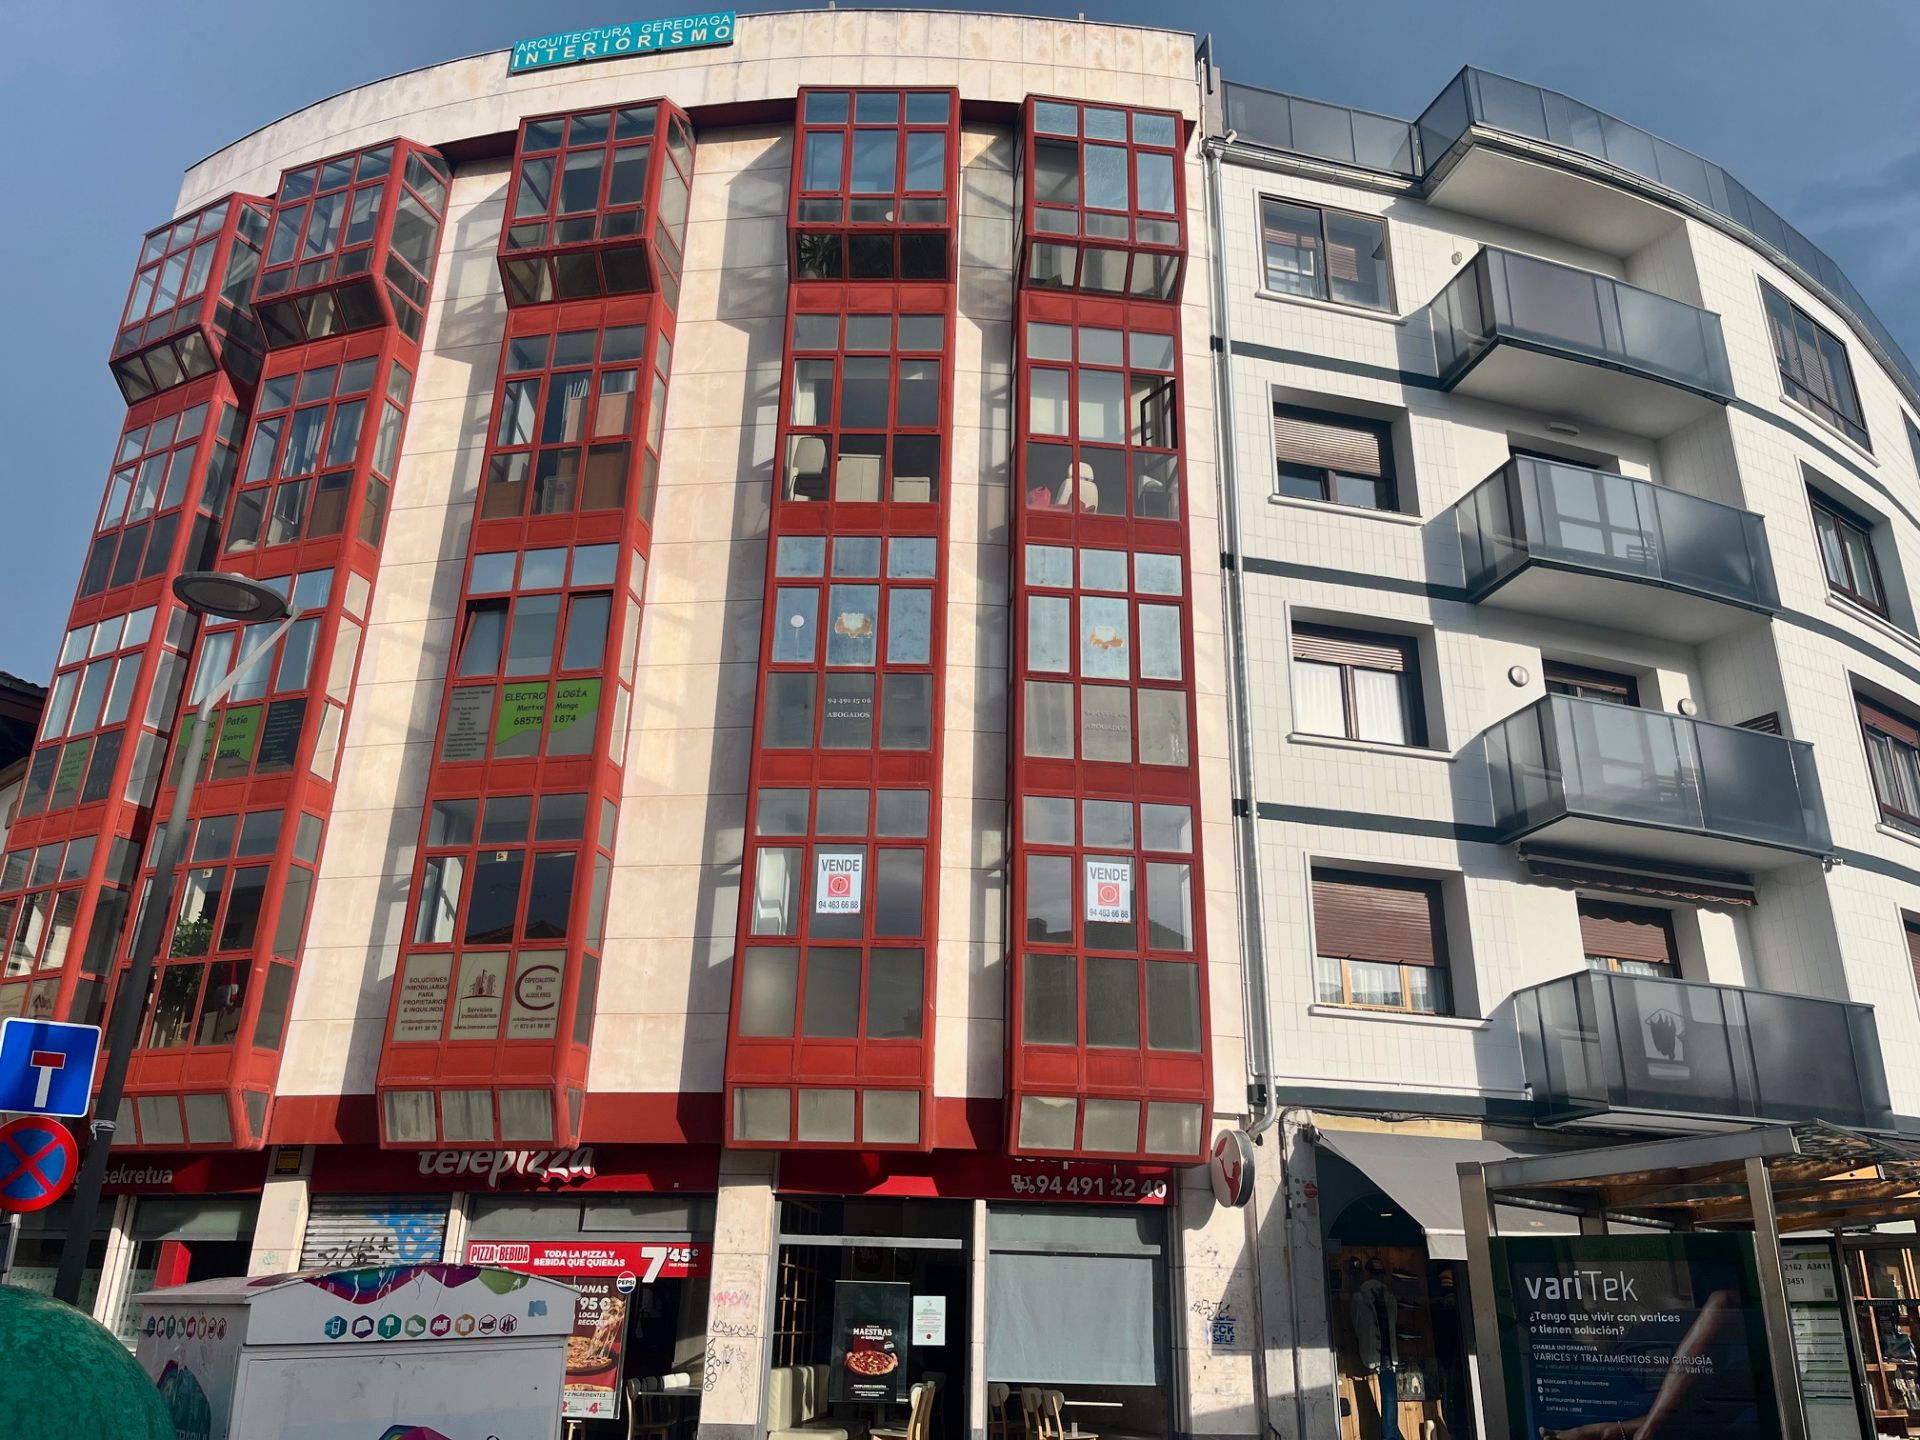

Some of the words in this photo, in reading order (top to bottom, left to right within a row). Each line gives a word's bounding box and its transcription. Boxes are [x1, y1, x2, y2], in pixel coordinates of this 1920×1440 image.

[517, 27, 631, 53] ARQUITECTURA
[641, 15, 731, 34] GEREDIAGA
[514, 26, 730, 67] INTERIORISMO
[505, 692, 546, 701] ELECTRO
[557, 687, 587, 698] LOGÍA
[821, 859, 860, 872] VENDE
[1090, 867, 1128, 881] VENDE
[818, 901, 827, 909] 94
[102, 1163, 173, 1184] sekretua
[418, 1147, 595, 1188] telepizza
[1036, 1175, 1063, 1194] 94
[1066, 1176, 1104, 1196] 491
[1110, 1178, 1136, 1197] 22
[1140, 1179, 1168, 1199] 40
[471, 1246, 495, 1261] PIZZA
[499, 1246, 529, 1261] BEBIDA
[544, 1250, 567, 1258] TODA
[569, 1250, 580, 1258] LA
[581, 1250, 606, 1258] PIZZA
[607, 1250, 616, 1258] Y
[533, 1258, 563, 1267] BEBIDA
[564, 1258, 585, 1267] QUE
[586, 1258, 626, 1267] QUIERAS
[1806, 1263, 1831, 1271] A3411
[1524, 1270, 1638, 1302] variTek
[1529, 1311, 1567, 1323] ¿Tengo
[1569, 1314, 1589, 1324] que
[1591, 1312, 1614, 1322] vivir
[1617, 1314, 1638, 1322] con
[1639, 1313, 1681, 1323] varices
[853, 1328, 893, 1336] MAESTRAS
[1538, 1325, 1572, 1334] tienen
[1574, 1325, 1625, 1336] solución?
[1533, 1352, 1571, 1362] VARICES
[1581, 1353, 1651, 1364] TRATAMIENTOS
[1653, 1355, 1669, 1365] SIN
[1671, 1354, 1713, 1366] CIRUGÍA
